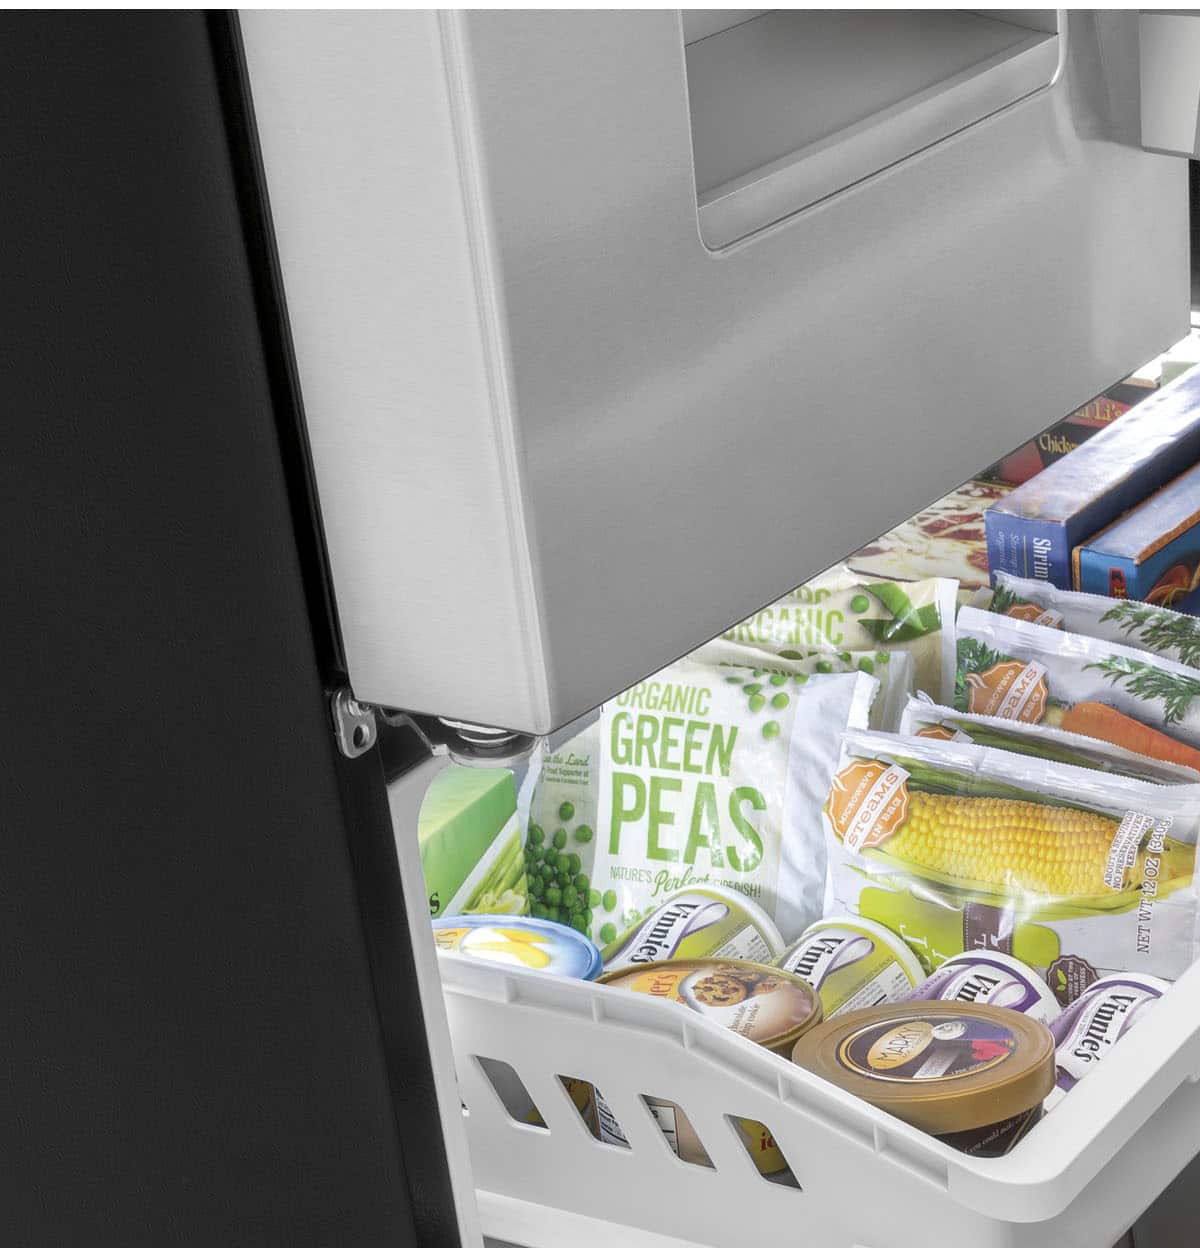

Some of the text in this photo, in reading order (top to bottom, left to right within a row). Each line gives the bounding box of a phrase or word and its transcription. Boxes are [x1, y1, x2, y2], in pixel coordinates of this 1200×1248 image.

[1033, 537, 1052, 579] Shrim
[609, 711, 739, 777] GREEN
[607, 772, 767, 873] PEAS
[1112, 876, 1122, 890] NO
[1144, 858, 1160, 878] OZ
[1142, 879, 1157, 896] 12
[1138, 900, 1153, 922] WT
[631, 903, 701, 963] Vinnie's
[1136, 925, 1151, 954] NET
[1073, 994, 1137, 1063] Vinnie's
